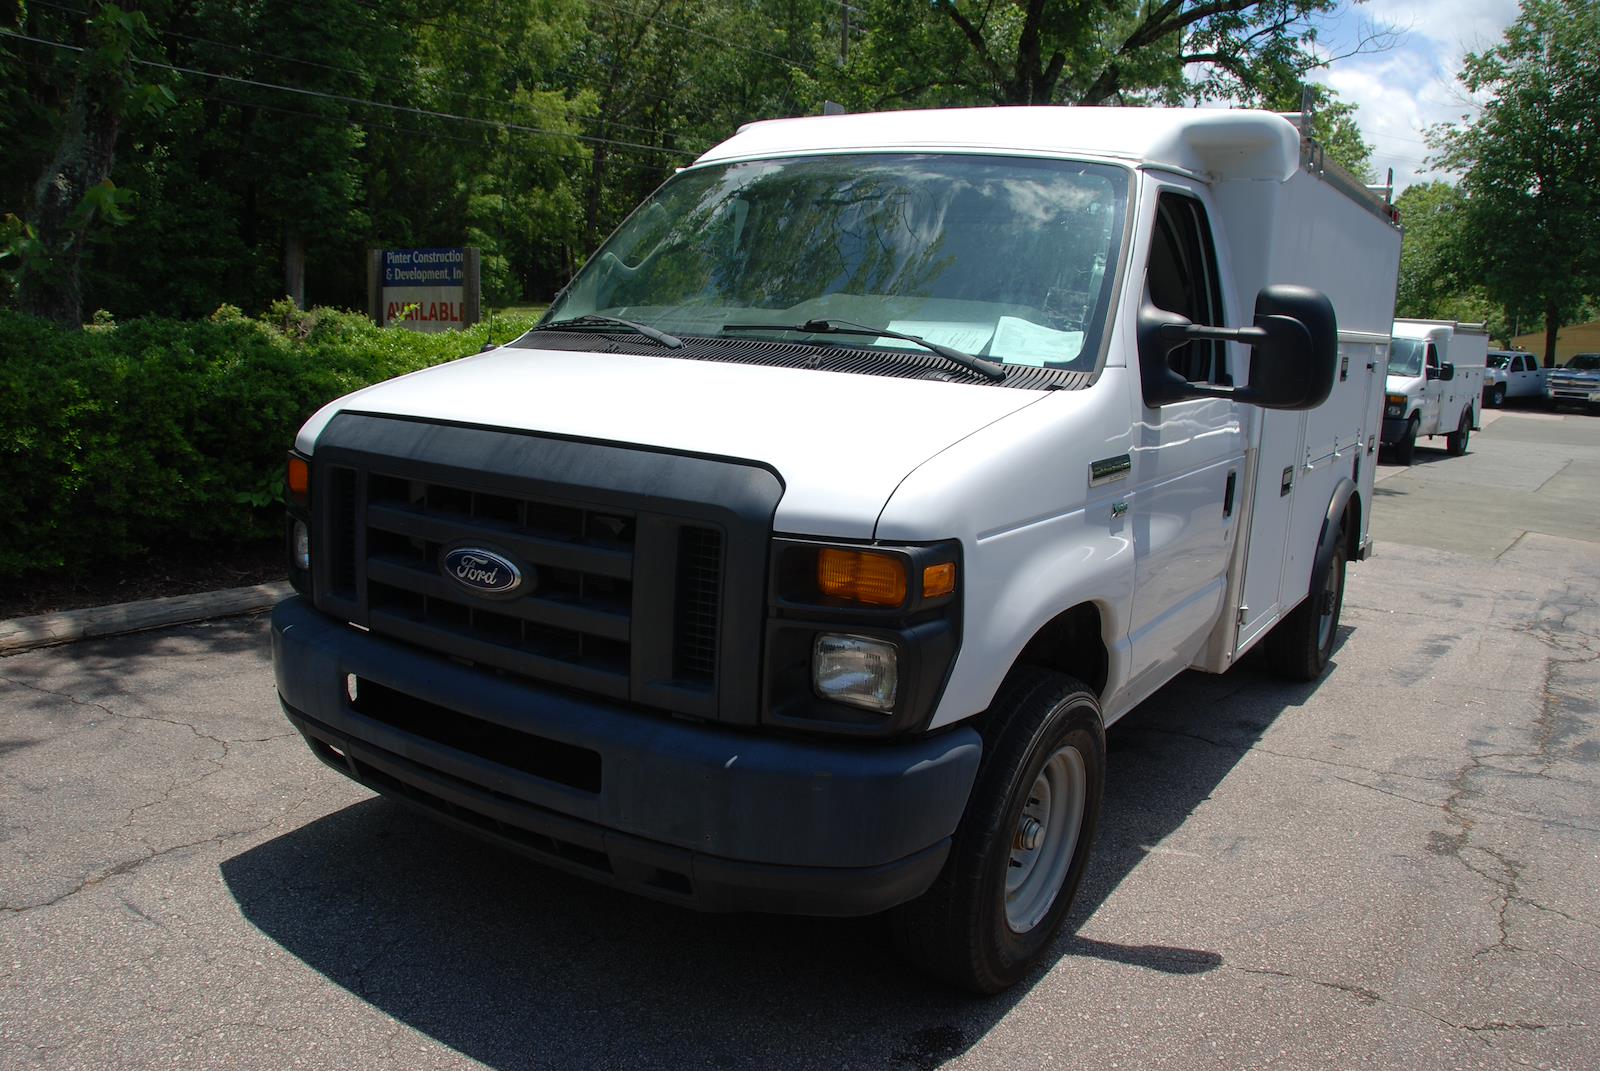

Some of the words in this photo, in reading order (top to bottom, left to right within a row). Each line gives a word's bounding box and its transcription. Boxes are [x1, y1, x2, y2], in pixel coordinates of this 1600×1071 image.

[386, 251, 411, 264] Pinter
[386, 268, 393, 280] &
[394, 267, 450, 282] Development,
[453, 266, 464, 279] In
[457, 555, 498, 585] Ford
